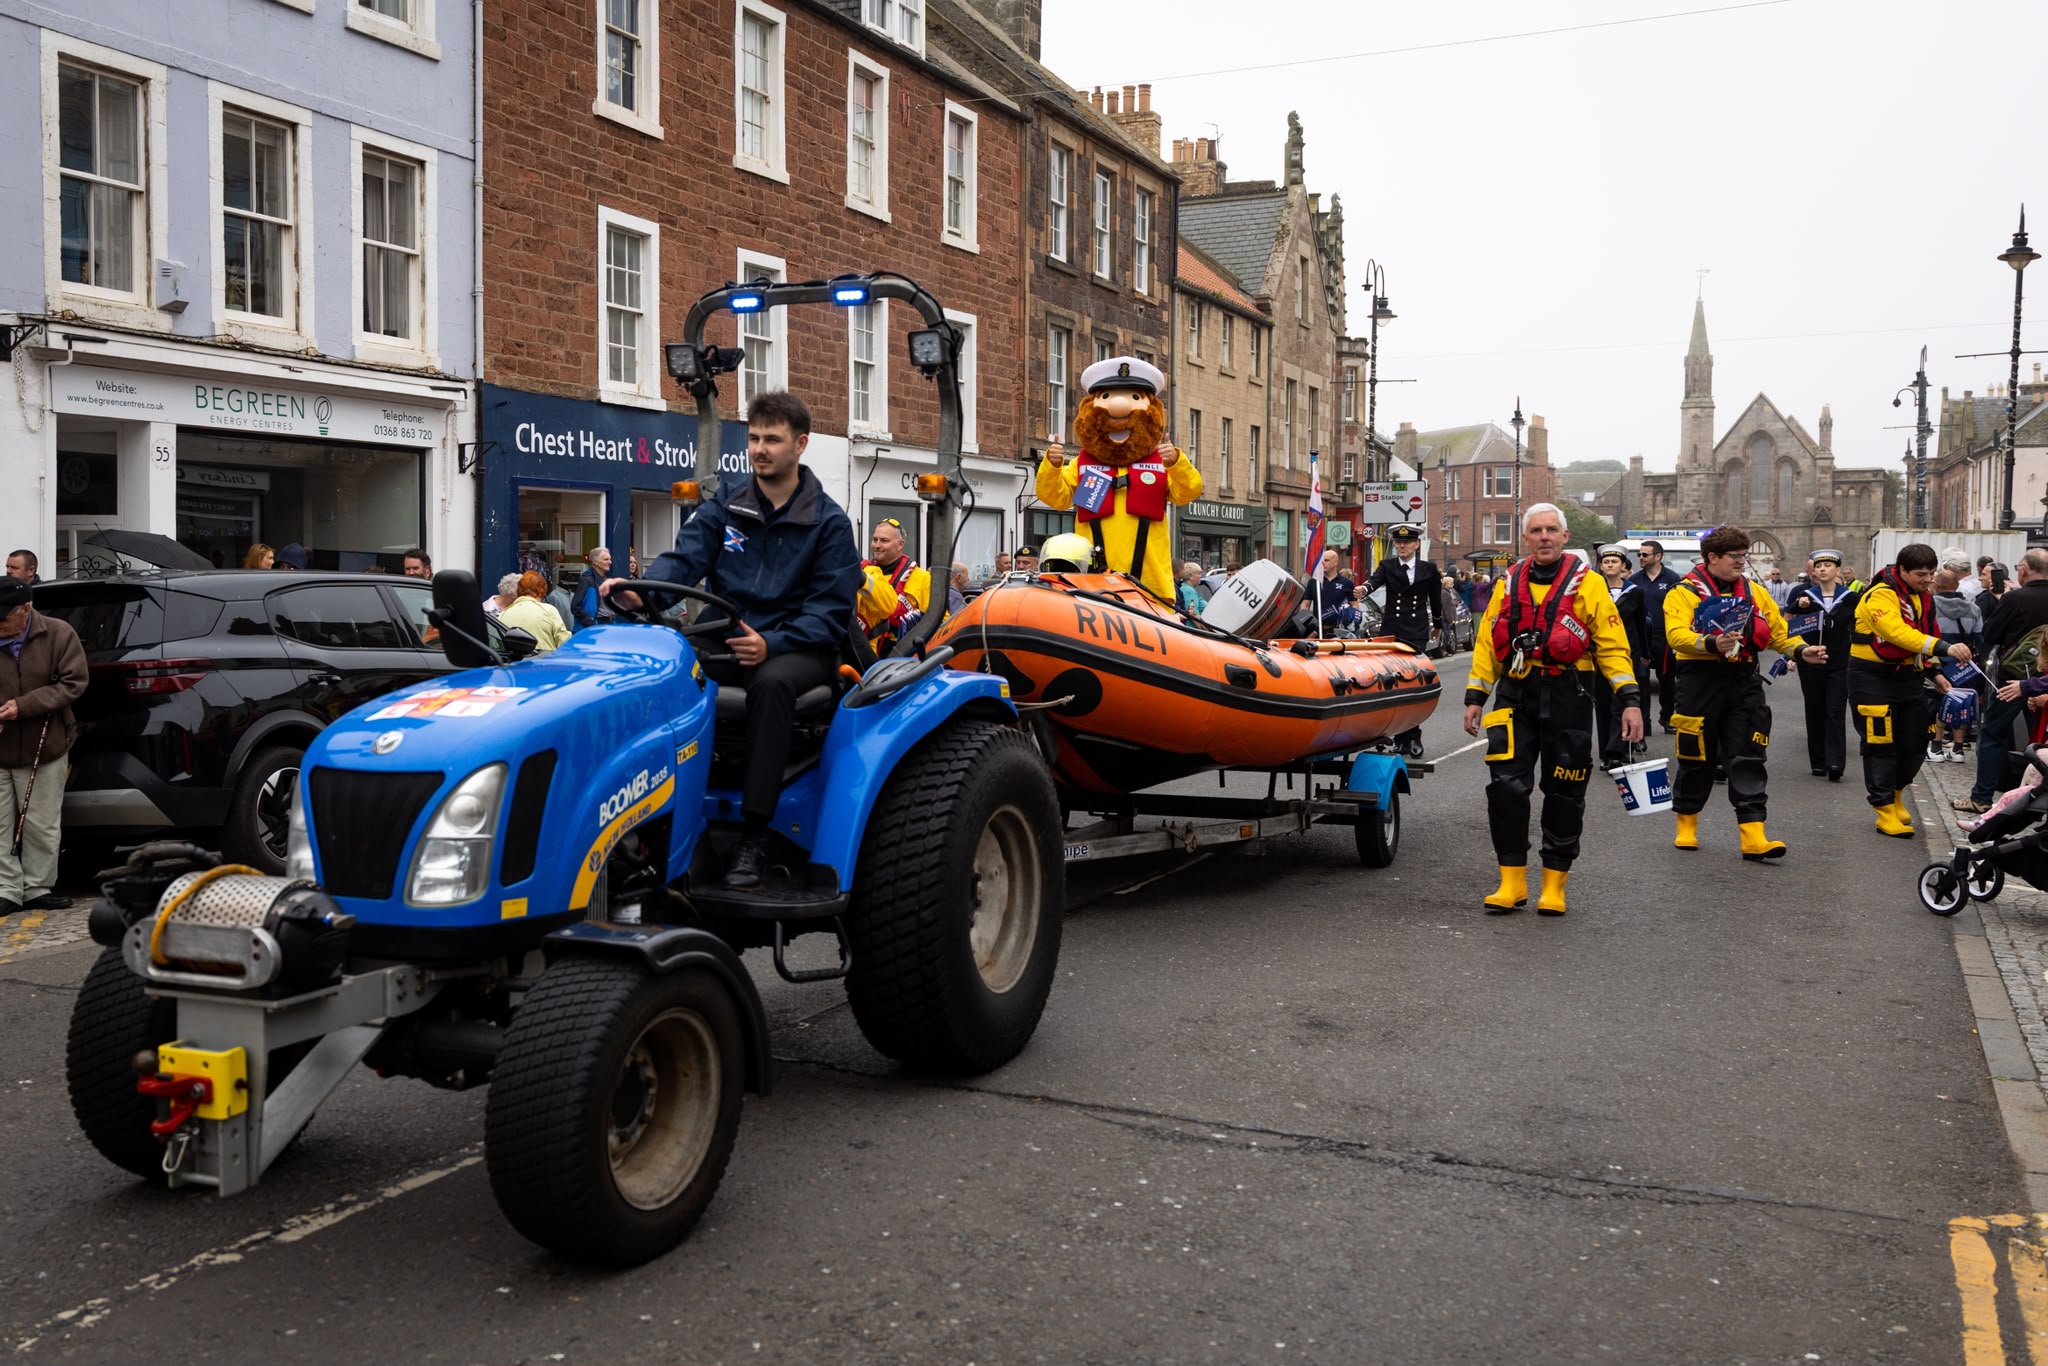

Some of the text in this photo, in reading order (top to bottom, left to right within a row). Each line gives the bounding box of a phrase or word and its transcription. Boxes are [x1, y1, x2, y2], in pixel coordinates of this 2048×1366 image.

[96, 380, 137, 395] Website:
[67, 394, 164, 410] www.begreencentres.co.uk
[195, 385, 305, 419] BEGREEN
[210, 415, 293, 431] ENERGY CENTRES
[382, 409, 425, 424] Telephone:
[374, 425, 432, 440] 01368 863 720
[155, 446, 170, 462] 55
[515, 422, 753, 473] Chest Heart & Strok cotl
[1188, 502, 1245, 520] CRUNCHY CARROT
[1228, 578, 1262, 609] RNLI
[1074, 603, 1167, 655] RNLI
[1564, 617, 1586, 639] RNLI
[1553, 766, 1586, 781] RNLI
[599, 769, 649, 828] BOOMER
[1651, 785, 1671, 797] Lifeb
[1064, 845, 1088, 858] nipe
